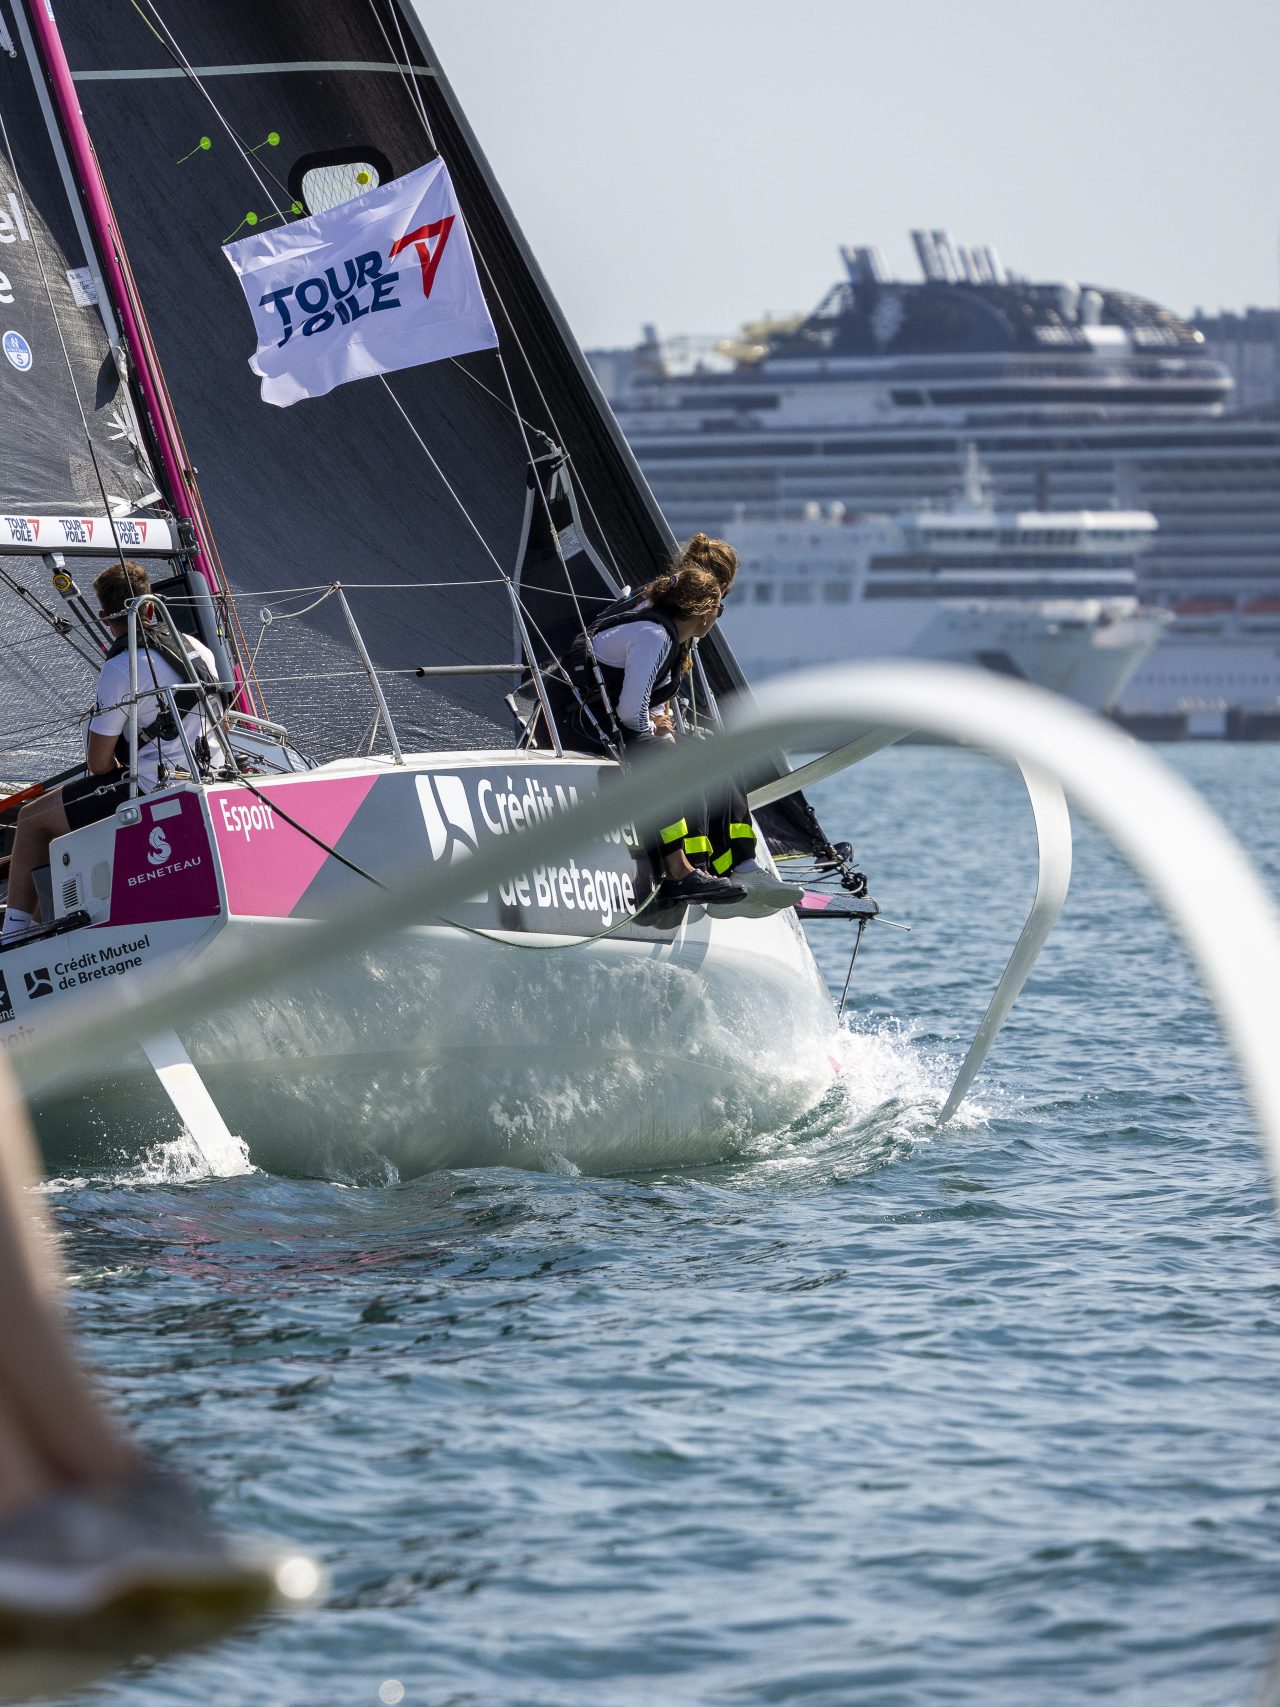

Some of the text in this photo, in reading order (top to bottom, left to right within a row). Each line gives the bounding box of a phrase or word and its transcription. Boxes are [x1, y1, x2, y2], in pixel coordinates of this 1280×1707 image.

[258, 250, 383, 326] TOUR
[4, 517, 28, 530] TOUR
[10, 528, 33, 542] VOILE
[58, 519, 82, 532] TOUR
[64, 530, 87, 543] VOILE
[113, 521, 136, 533] TOUR
[118, 531, 141, 544] VOILE
[219, 796, 275, 842] Espoir
[477, 775, 554, 836] Crédit
[127, 856, 202, 887] BENETEAU
[531, 858, 637, 927] Bretagne
[54, 934, 151, 977] Crédit Mutuel
[58, 954, 143, 991] de Bretagne
